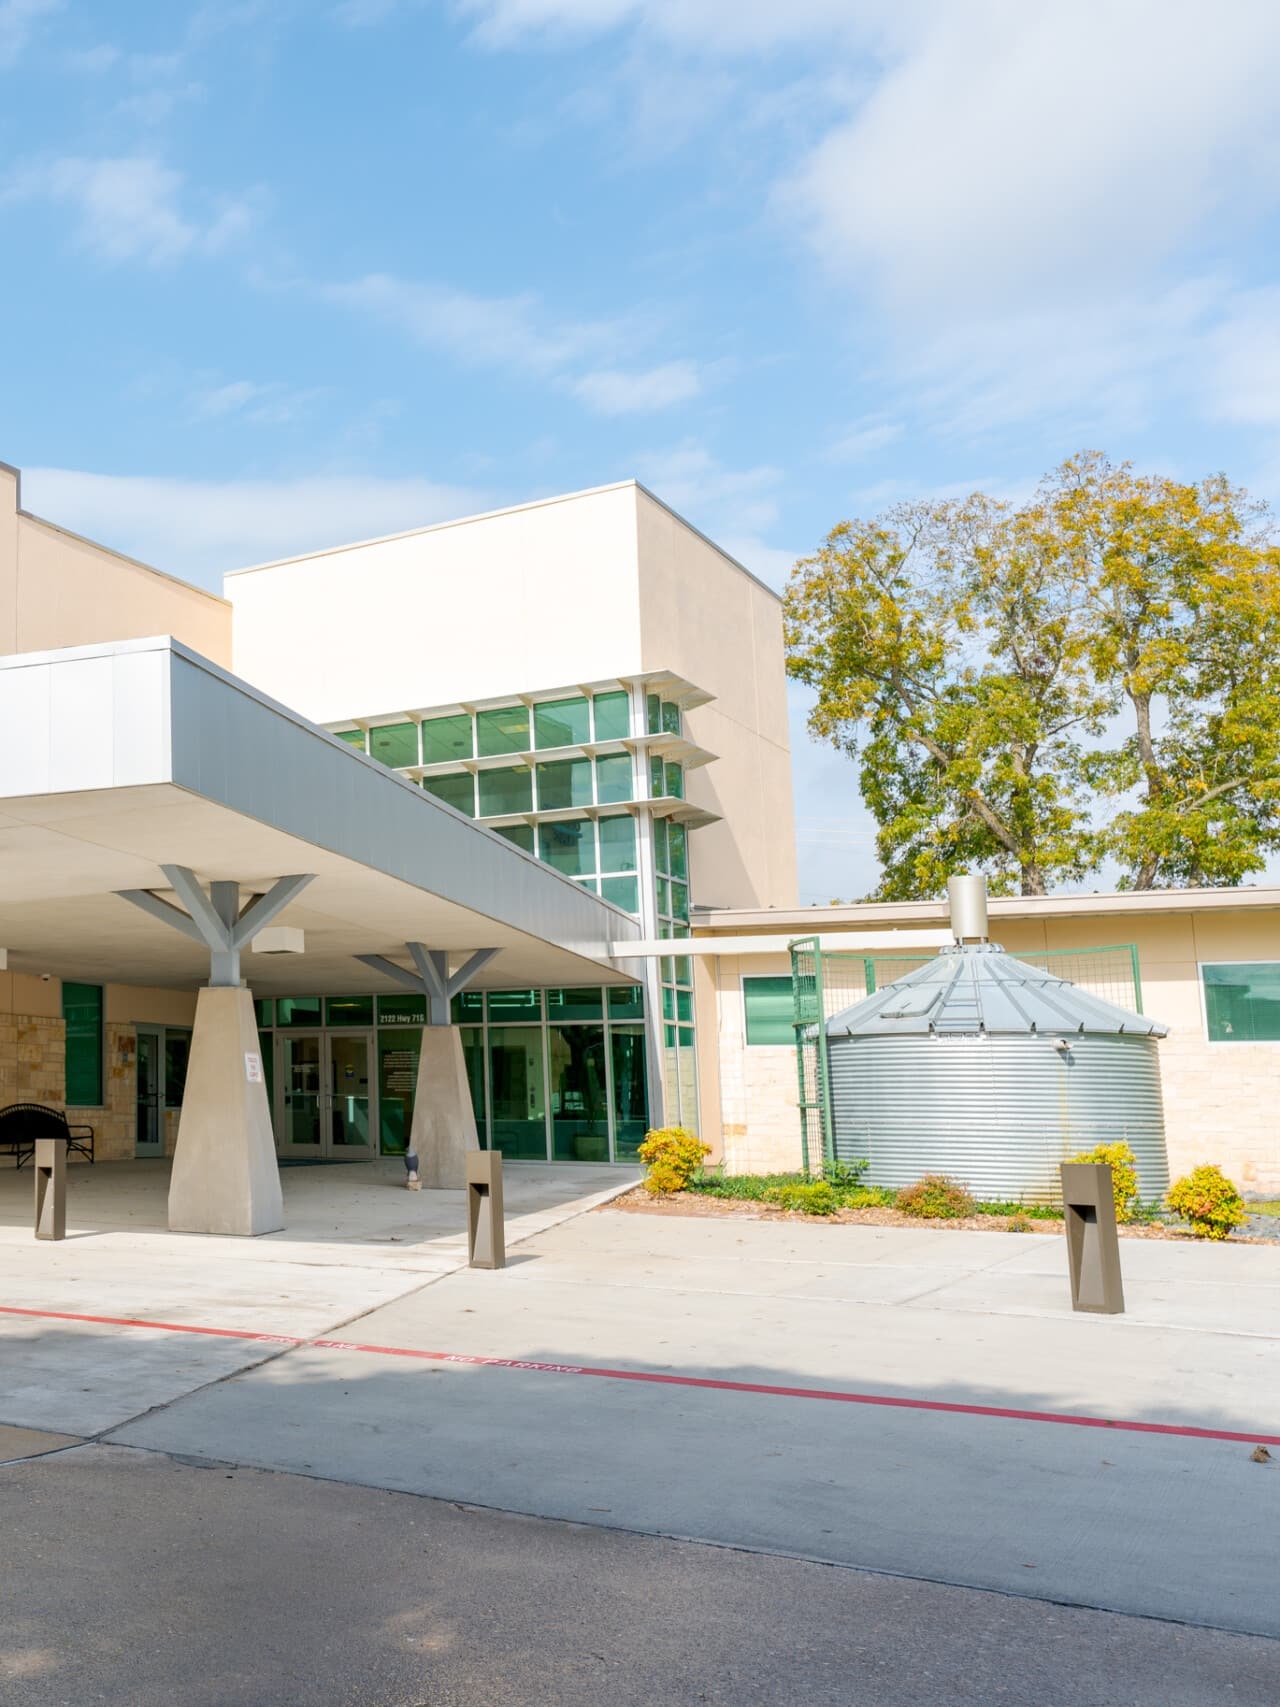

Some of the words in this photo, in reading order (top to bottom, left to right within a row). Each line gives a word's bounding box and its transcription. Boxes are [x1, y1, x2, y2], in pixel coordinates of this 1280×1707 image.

[397, 1014, 411, 1024] Hwy
[444, 1354, 476, 1363] NO
[481, 1358, 583, 1375] PARKING
